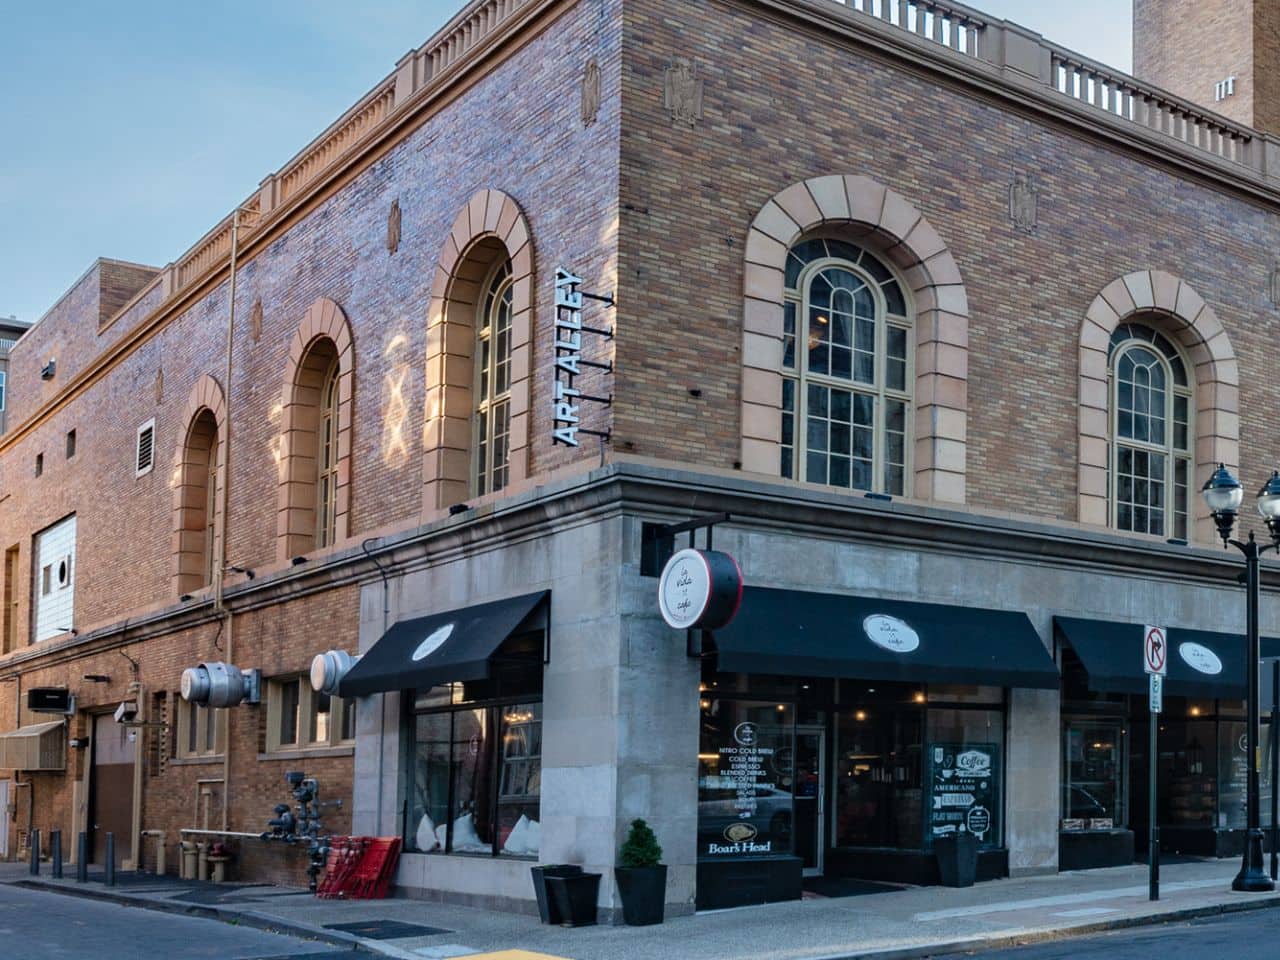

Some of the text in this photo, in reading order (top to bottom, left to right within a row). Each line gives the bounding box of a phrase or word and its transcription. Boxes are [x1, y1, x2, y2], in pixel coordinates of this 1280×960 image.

[553, 267, 583, 447] ART ALLEY
[960, 756, 985, 768] Coffee
[709, 841, 771, 854] Boar's Head
